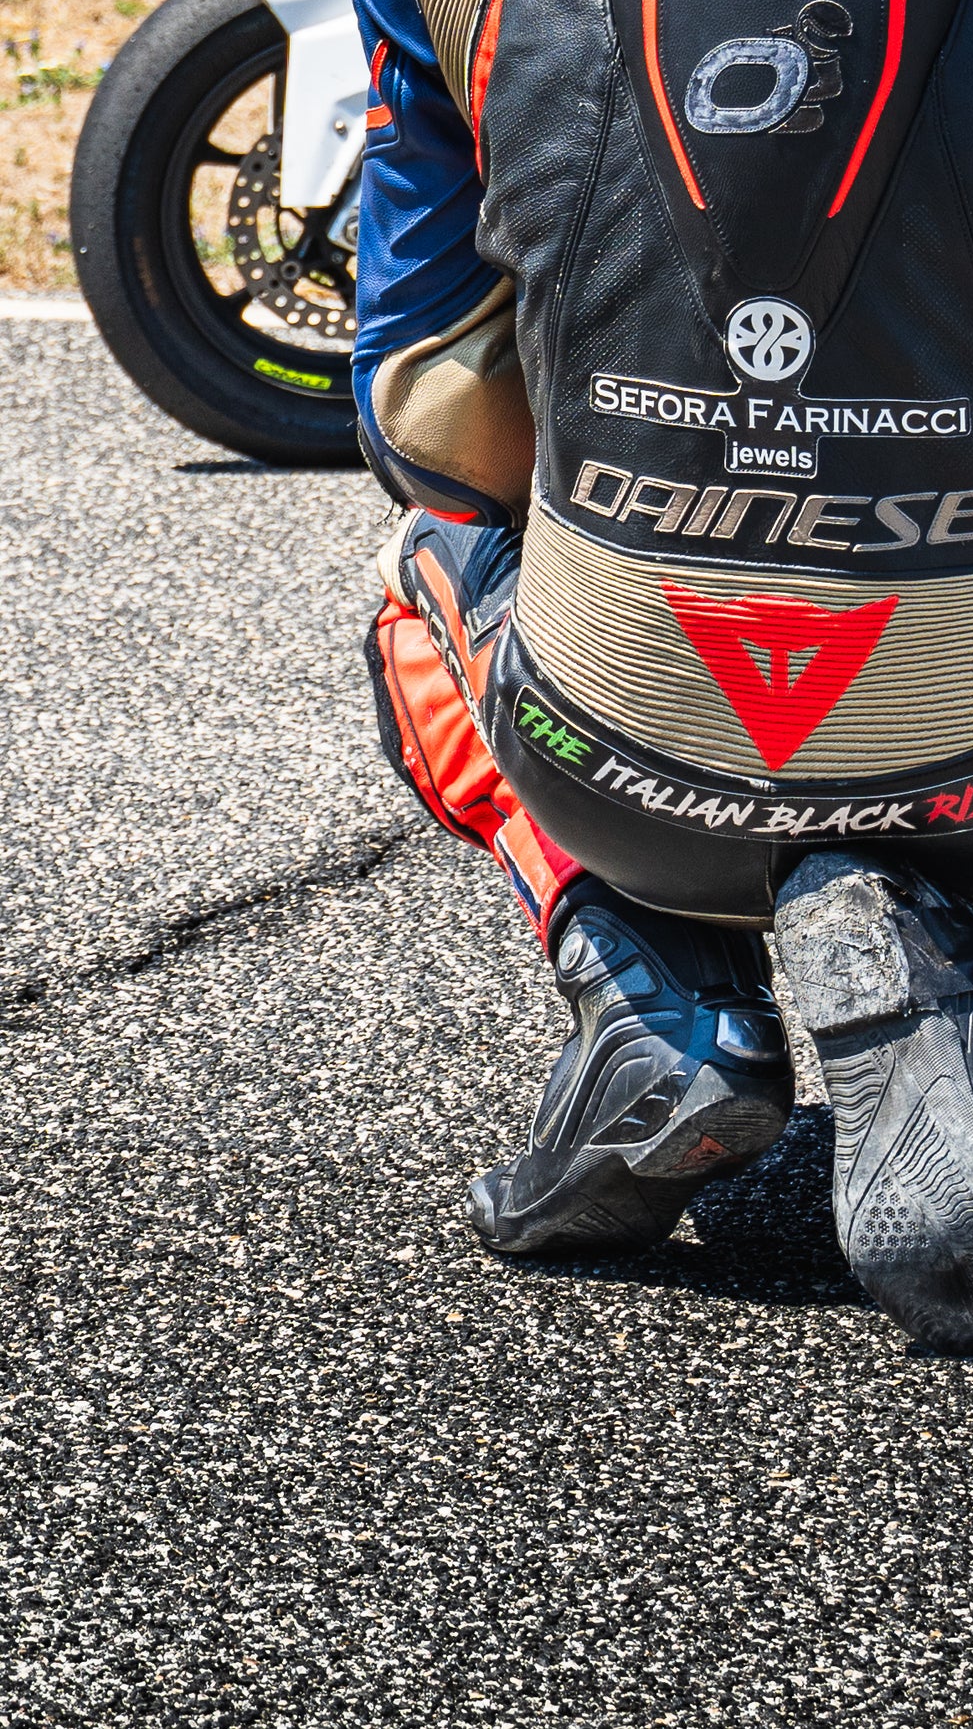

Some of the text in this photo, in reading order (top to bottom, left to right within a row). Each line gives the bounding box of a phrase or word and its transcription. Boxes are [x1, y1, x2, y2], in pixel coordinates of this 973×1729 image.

[594, 379, 969, 435] SEFORA FARINACCI
[730, 441, 813, 469] jewels
[519, 702, 594, 766] THE
[591, 754, 755, 829] ITALIAN
[747, 799, 917, 837] BLACK
